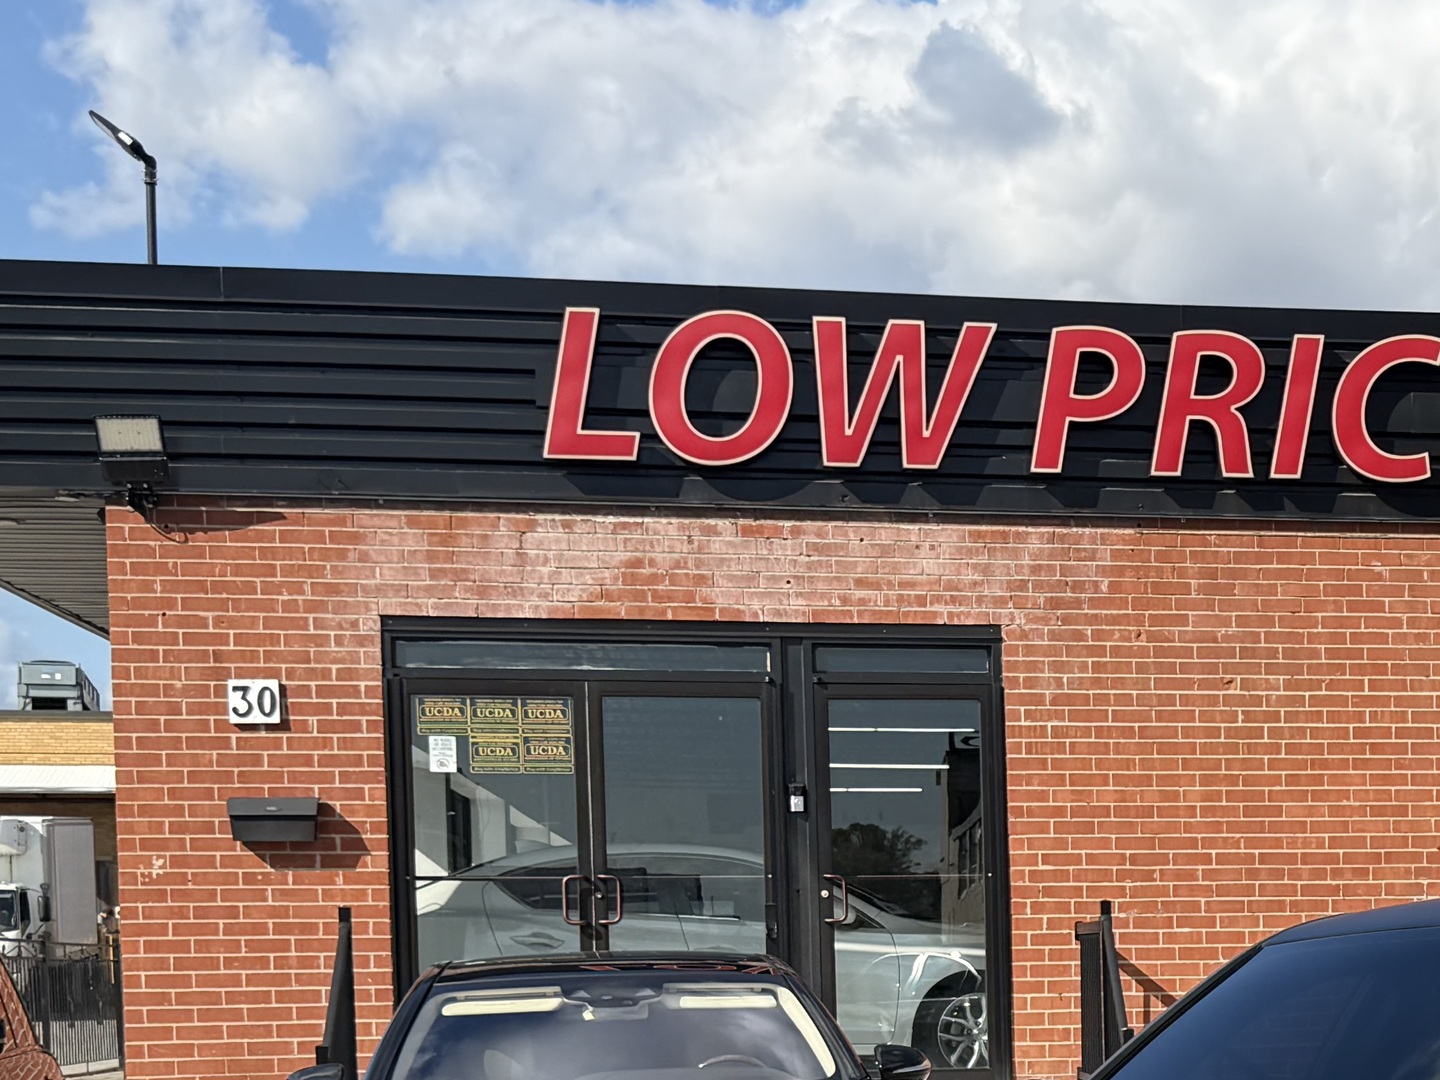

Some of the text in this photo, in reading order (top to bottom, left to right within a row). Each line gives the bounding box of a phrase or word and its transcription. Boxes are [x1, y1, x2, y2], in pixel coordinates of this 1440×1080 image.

[542, 306, 998, 467] LOW
[231, 685, 278, 718] 30
[425, 707, 462, 717] UCDA
[477, 708, 513, 718] UCDA
[528, 709, 564, 719] UCDA
[479, 746, 514, 757] UCDA
[530, 745, 566, 756] UCDA
